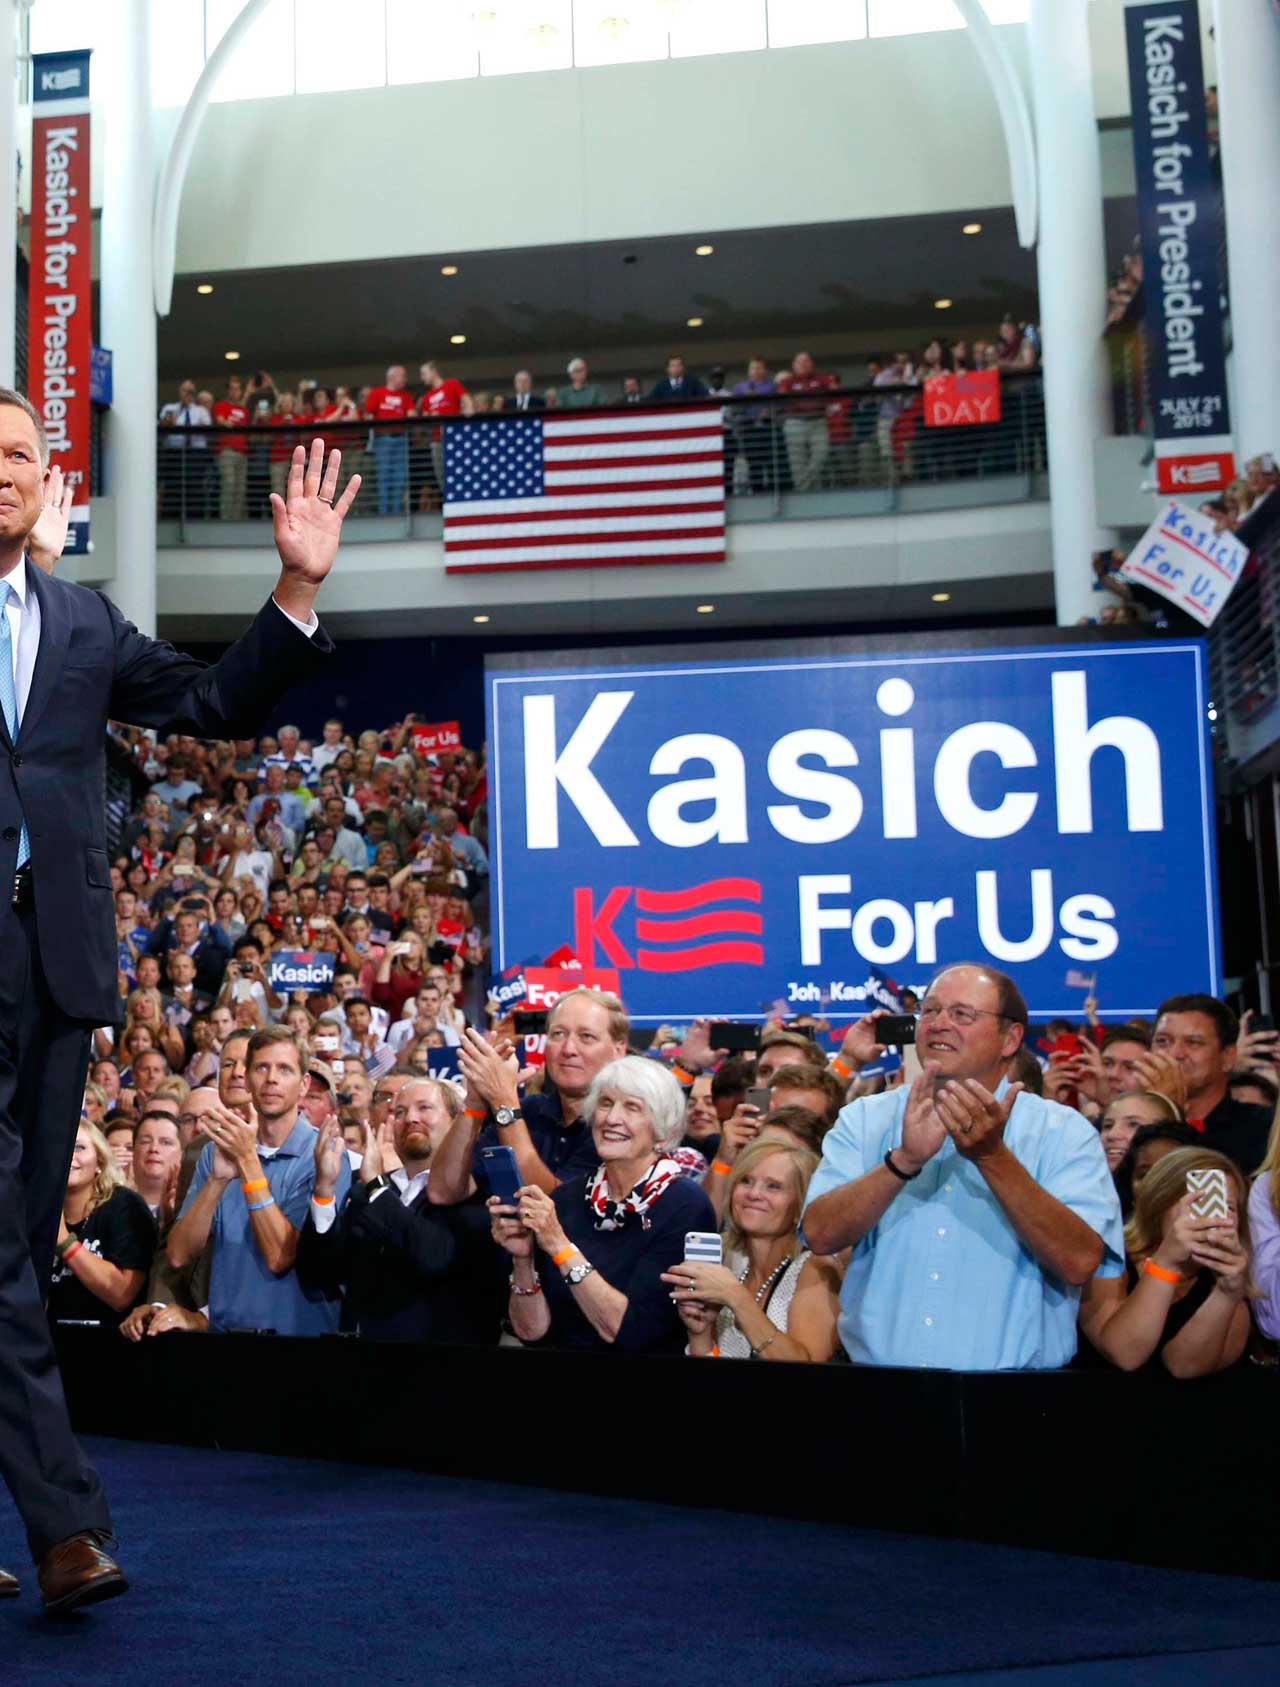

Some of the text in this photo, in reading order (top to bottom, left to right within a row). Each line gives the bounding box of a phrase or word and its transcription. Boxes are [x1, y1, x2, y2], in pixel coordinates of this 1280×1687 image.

[1143, 15, 1205, 378] Kasich for President
[43, 127, 79, 452] Kasich for President
[933, 396, 993, 426] DAY
[1159, 395, 1222, 416] JULY 21
[1164, 507, 1238, 575] Kasich
[1141, 544, 1218, 608] For Us
[414, 731, 459, 750] For Us
[523, 670, 1164, 849] Kasich
[798, 874, 953, 967] For
[976, 869, 1120, 962] Us
[272, 963, 335, 982] Kasich
[487, 975, 527, 1002] Kasi
